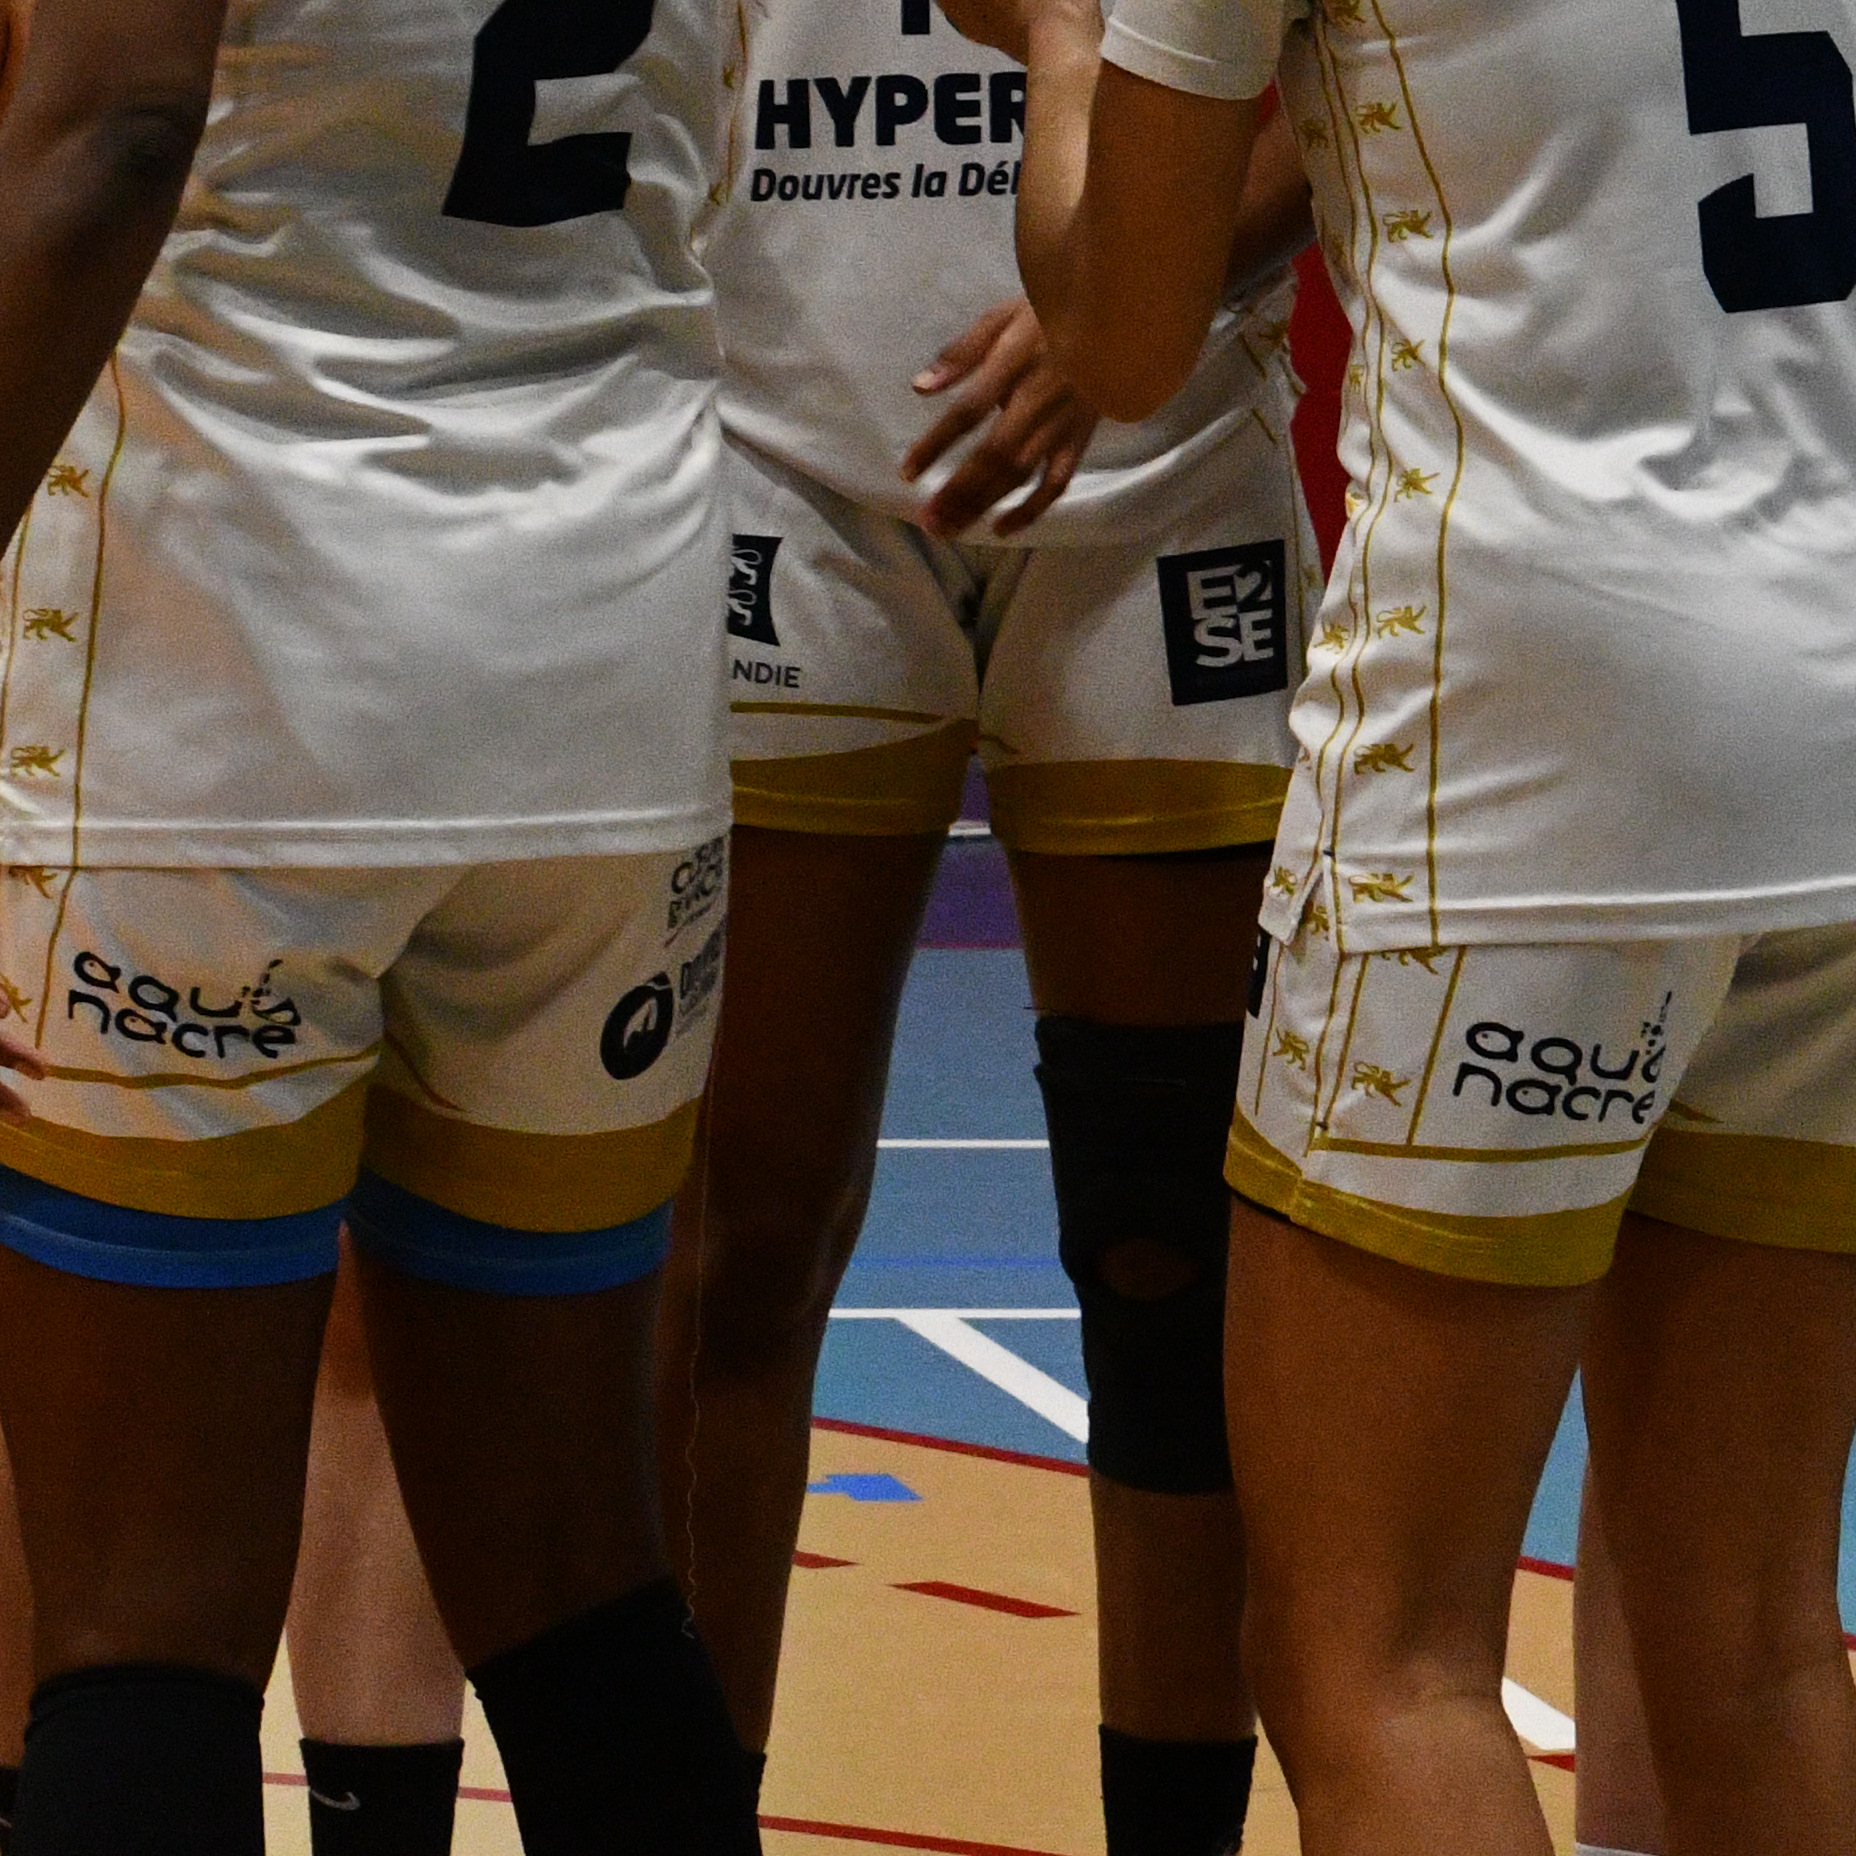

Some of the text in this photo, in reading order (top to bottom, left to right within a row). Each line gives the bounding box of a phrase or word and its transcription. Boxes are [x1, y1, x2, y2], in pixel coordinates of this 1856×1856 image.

[754, 71, 1027, 150] HYPER
[750, 167, 902, 202] Douvres
[910, 163, 948, 199] la
[67, 989, 297, 1059] nacre
[1452, 1063, 1656, 1125] nacre
